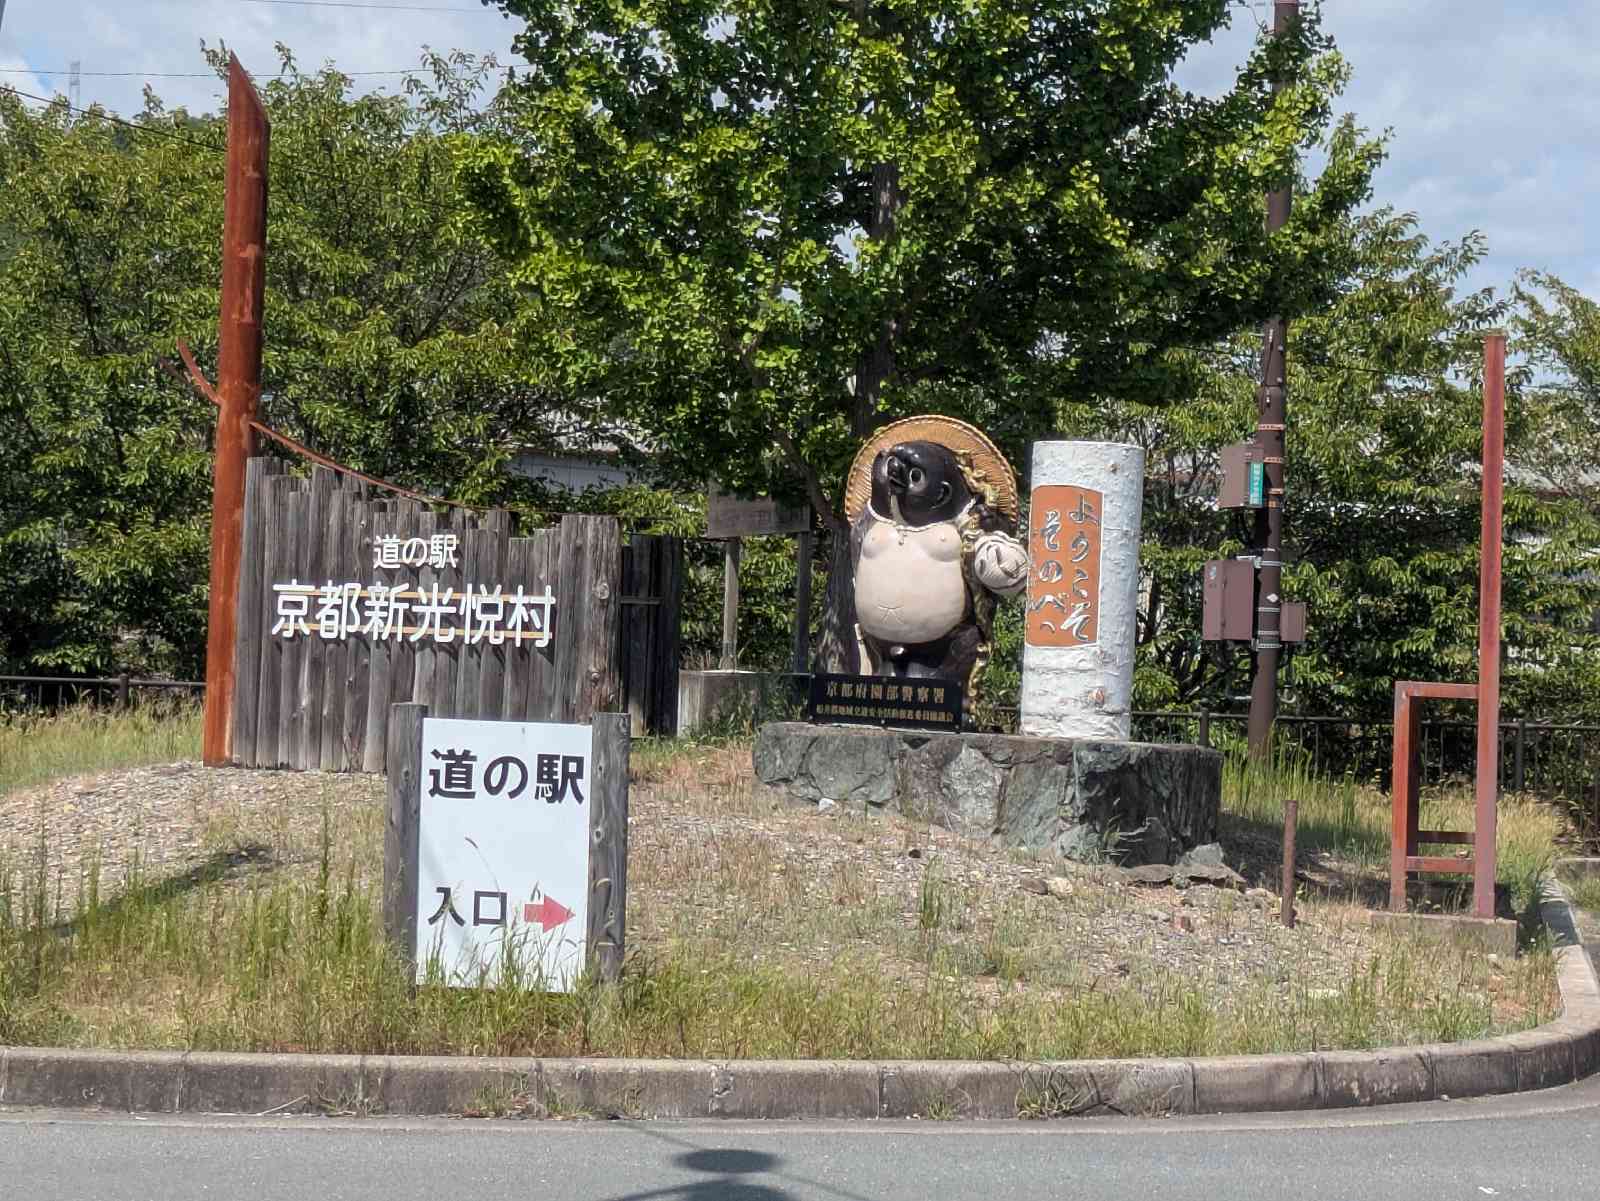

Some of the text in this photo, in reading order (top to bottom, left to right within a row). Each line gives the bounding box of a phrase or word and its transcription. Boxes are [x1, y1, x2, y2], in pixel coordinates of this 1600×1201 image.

[373, 534, 457, 569] 道の駅
[1061, 493, 1098, 642] ようこそ
[271, 579, 556, 648] 京都新光悦村
[428, 748, 585, 804] 道の駅
[427, 886, 507, 927] 入口
